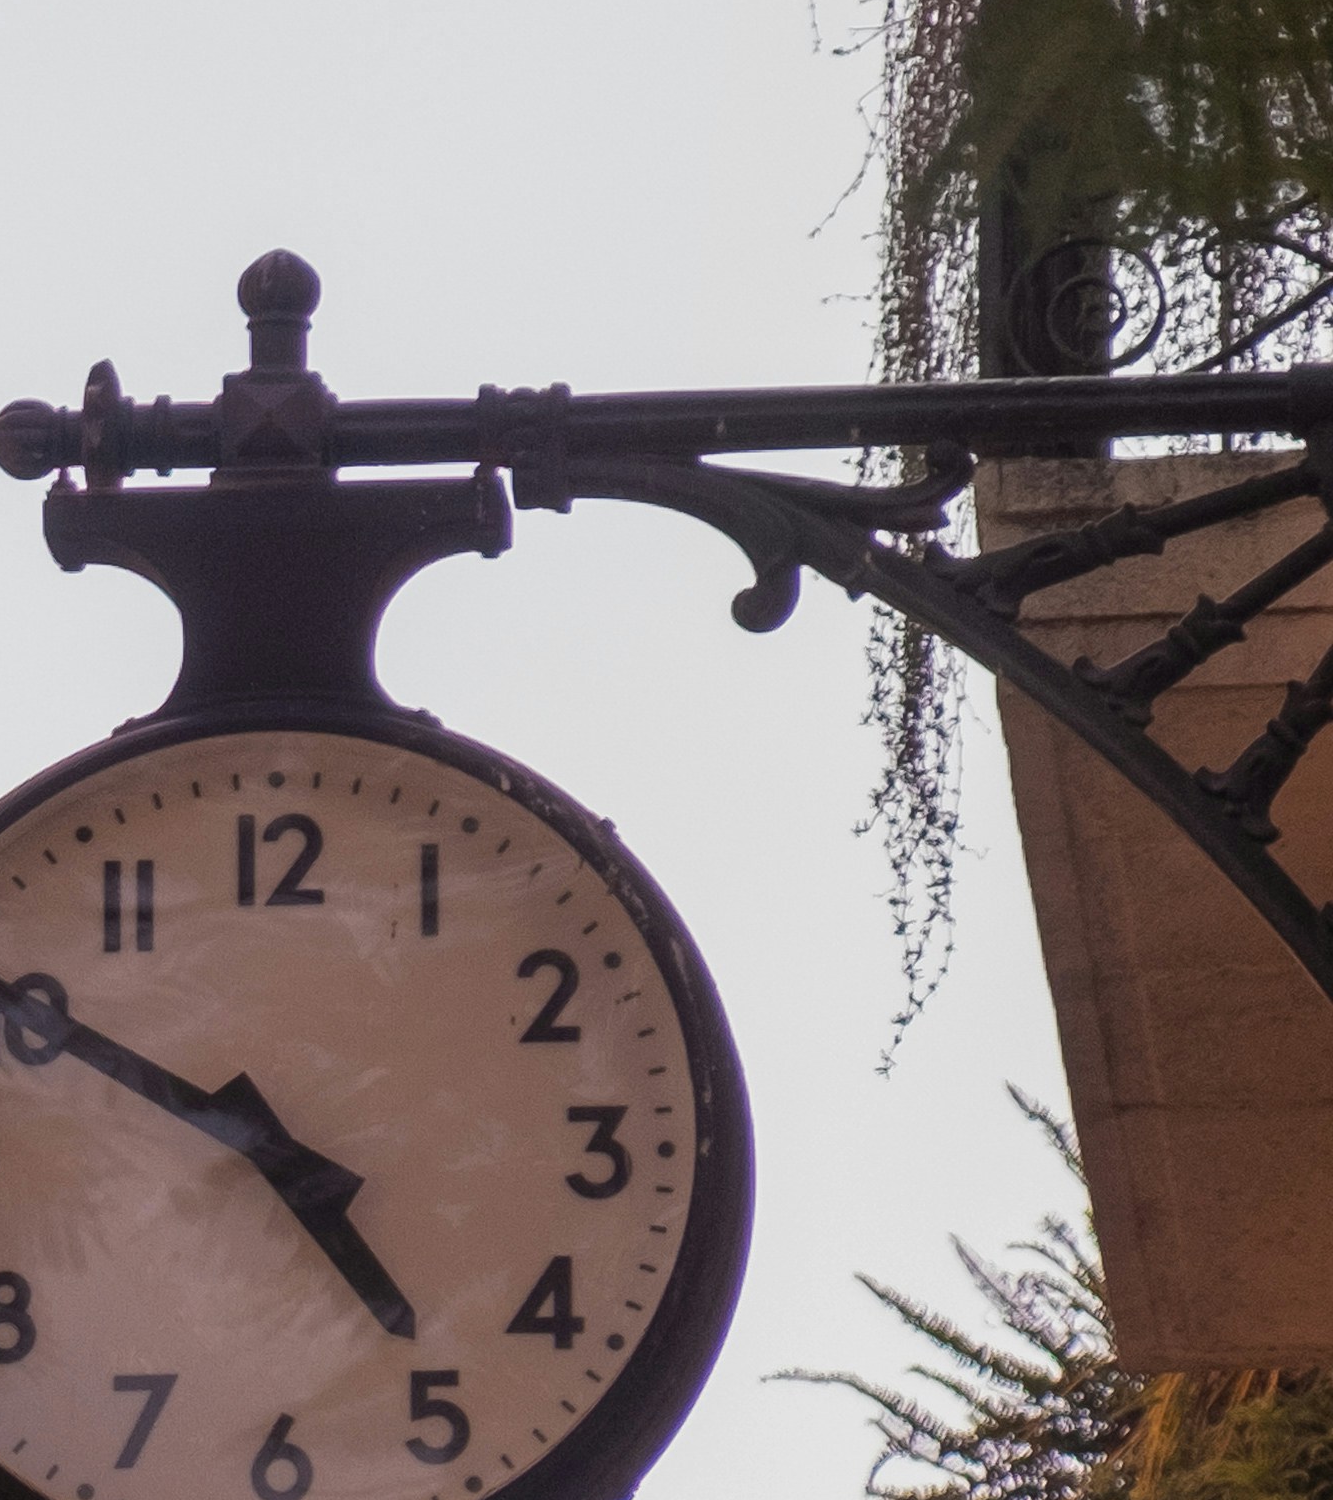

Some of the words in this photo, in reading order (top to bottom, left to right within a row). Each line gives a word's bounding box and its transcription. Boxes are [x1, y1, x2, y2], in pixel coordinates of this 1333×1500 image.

[102, 859, 155, 953] 11
[237, 813, 324, 906] 12
[420, 843, 439, 936] 1
[517, 947, 582, 1044] 2
[565, 1105, 632, 1200] 3
[505, 1256, 584, 1350] 4
[112, 1374, 178, 1470] 7
[406, 1370, 470, 1463] 5
